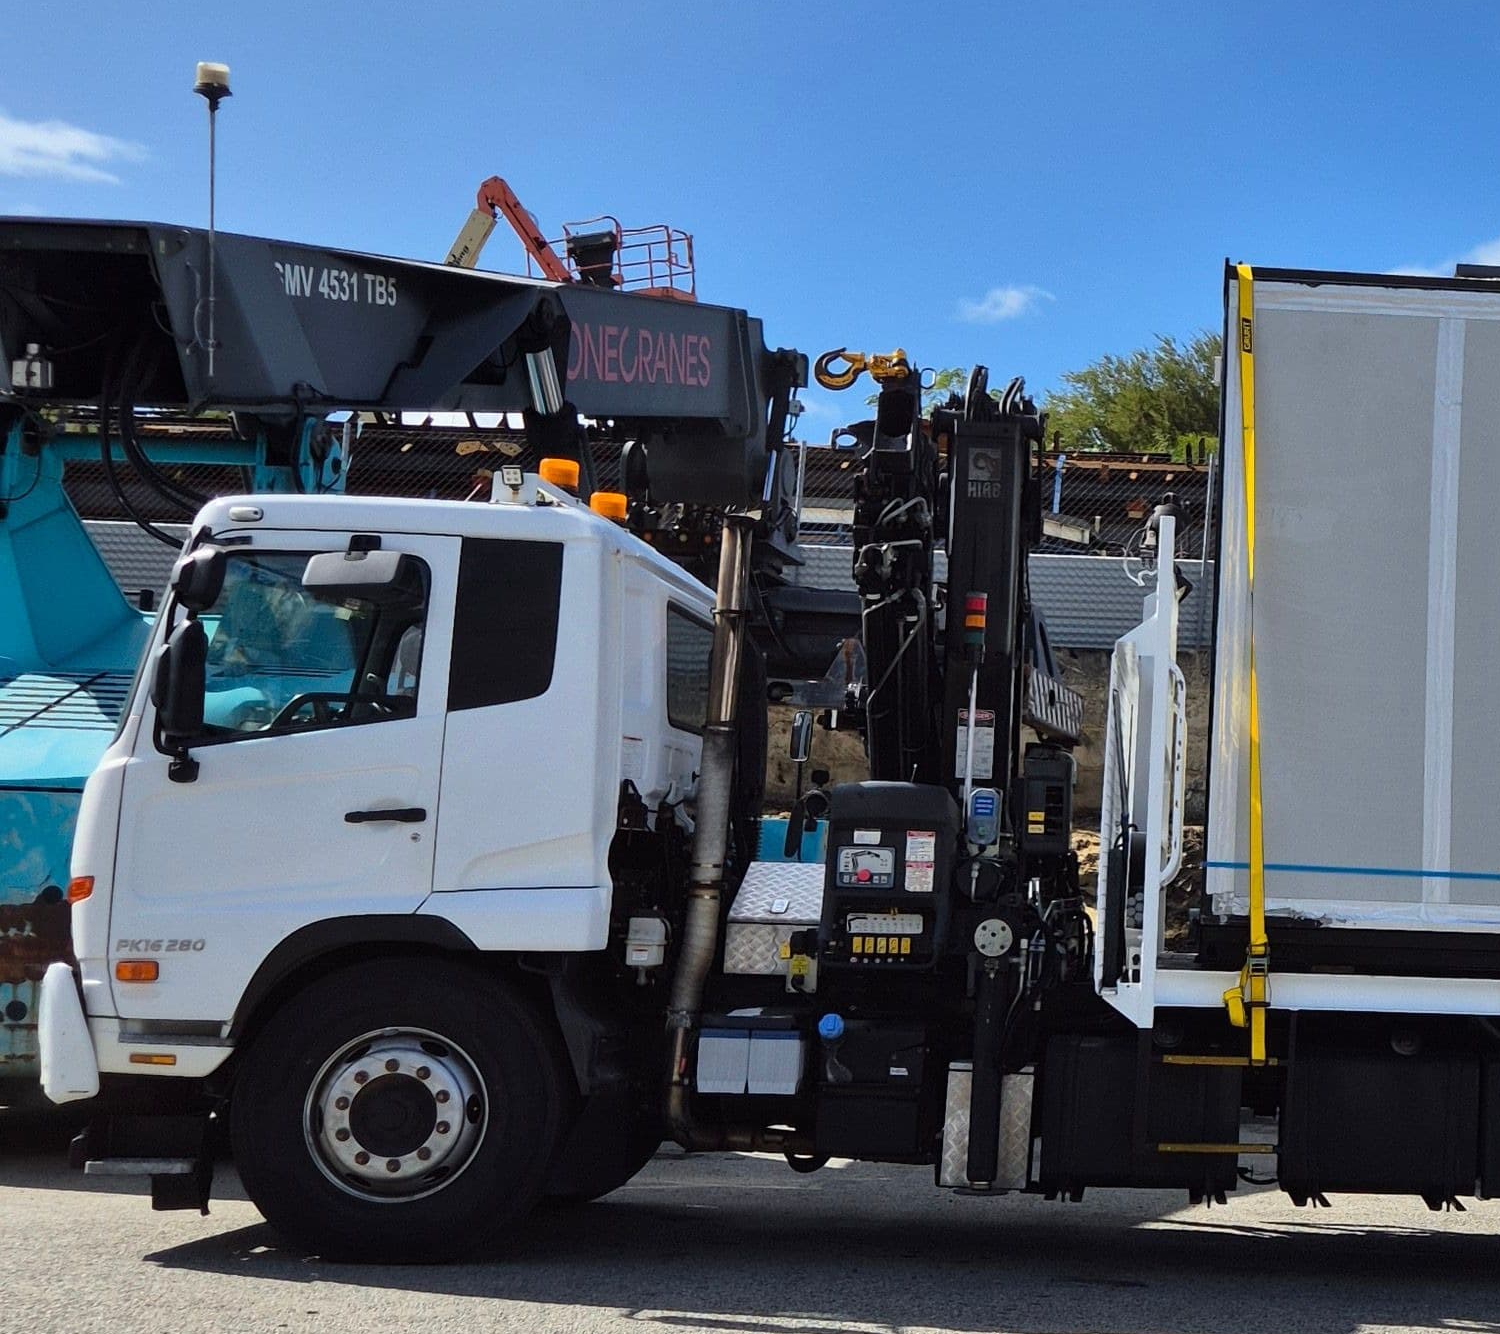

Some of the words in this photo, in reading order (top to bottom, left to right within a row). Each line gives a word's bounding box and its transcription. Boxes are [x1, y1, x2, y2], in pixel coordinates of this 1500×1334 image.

[318, 268, 359, 302] 4531
[363, 273, 397, 306] TB5
[566, 320, 711, 387] ONECRANES
[967, 481, 1001, 498] HIAB
[115, 938, 163, 952] PK16
[165, 938, 206, 952] 280
